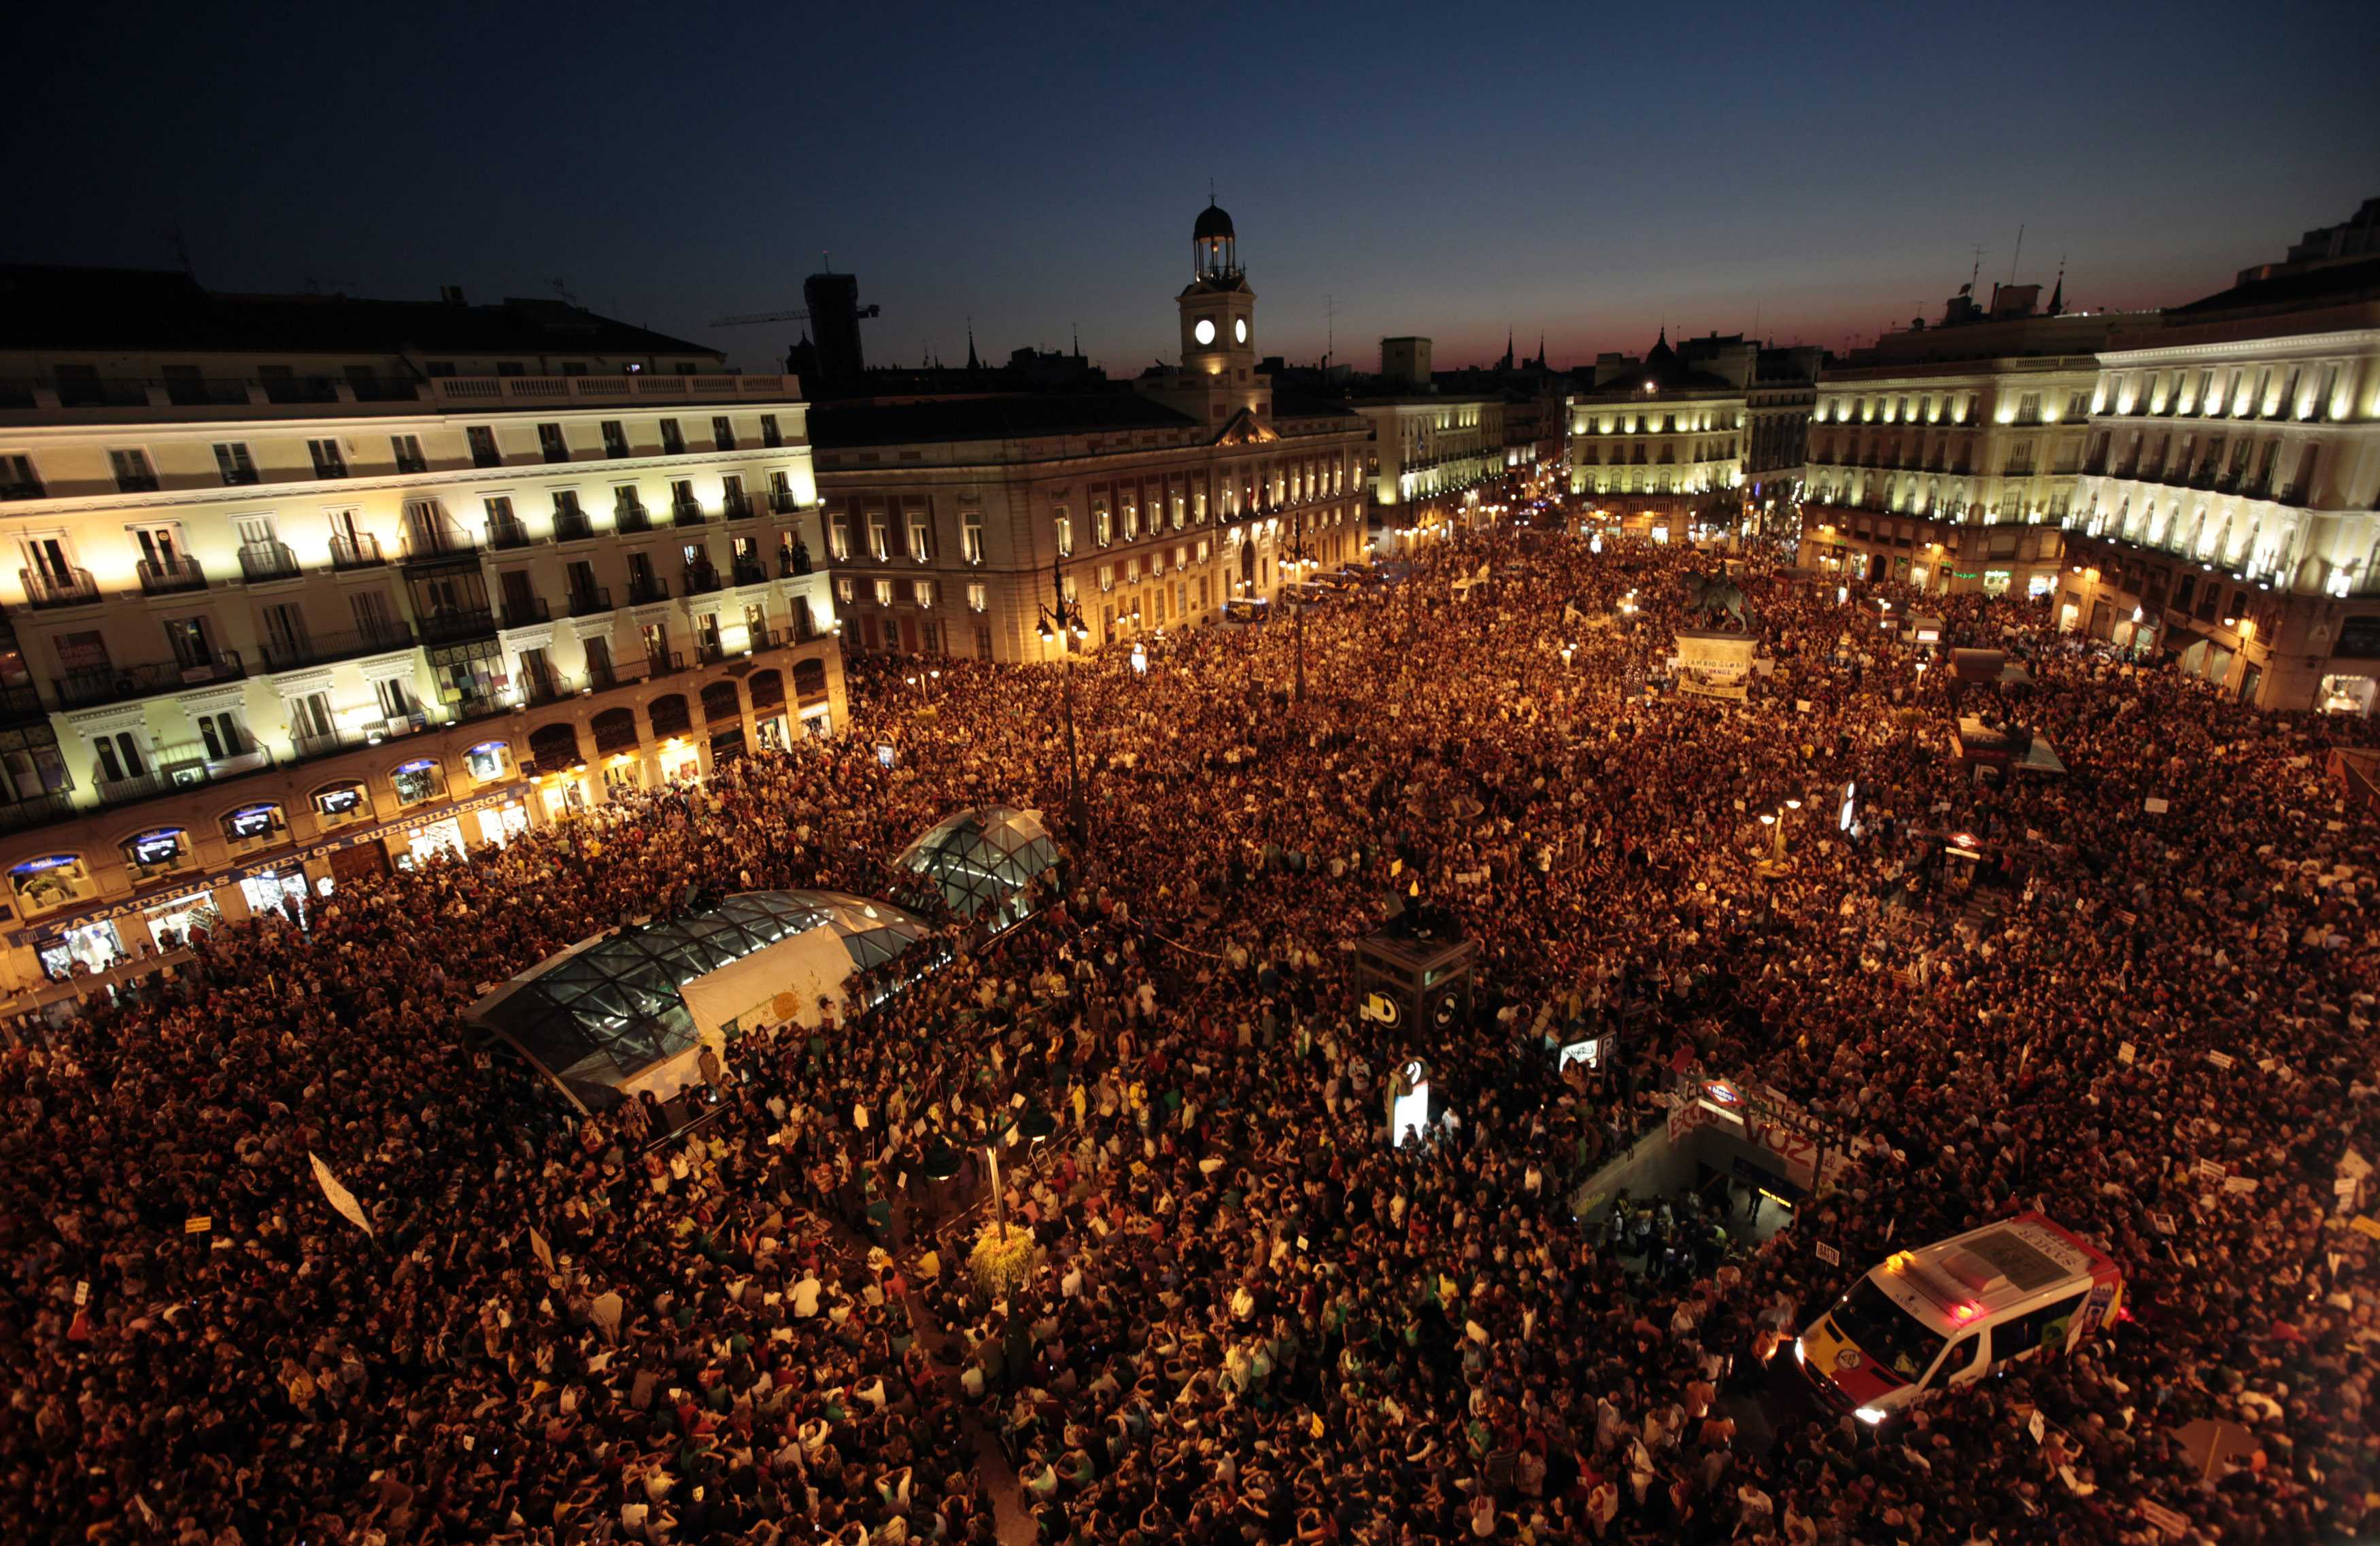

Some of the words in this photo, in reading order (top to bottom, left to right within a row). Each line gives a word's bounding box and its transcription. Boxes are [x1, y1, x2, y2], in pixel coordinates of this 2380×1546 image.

[593, 719, 634, 736] TOPSHOP
[49, 874, 232, 935] ZAPATERIAS
[243, 842, 341, 876] NUEVOS
[353, 791, 509, 844] GUERRILLEROS
[1712, 1086, 1733, 1101] Metro
